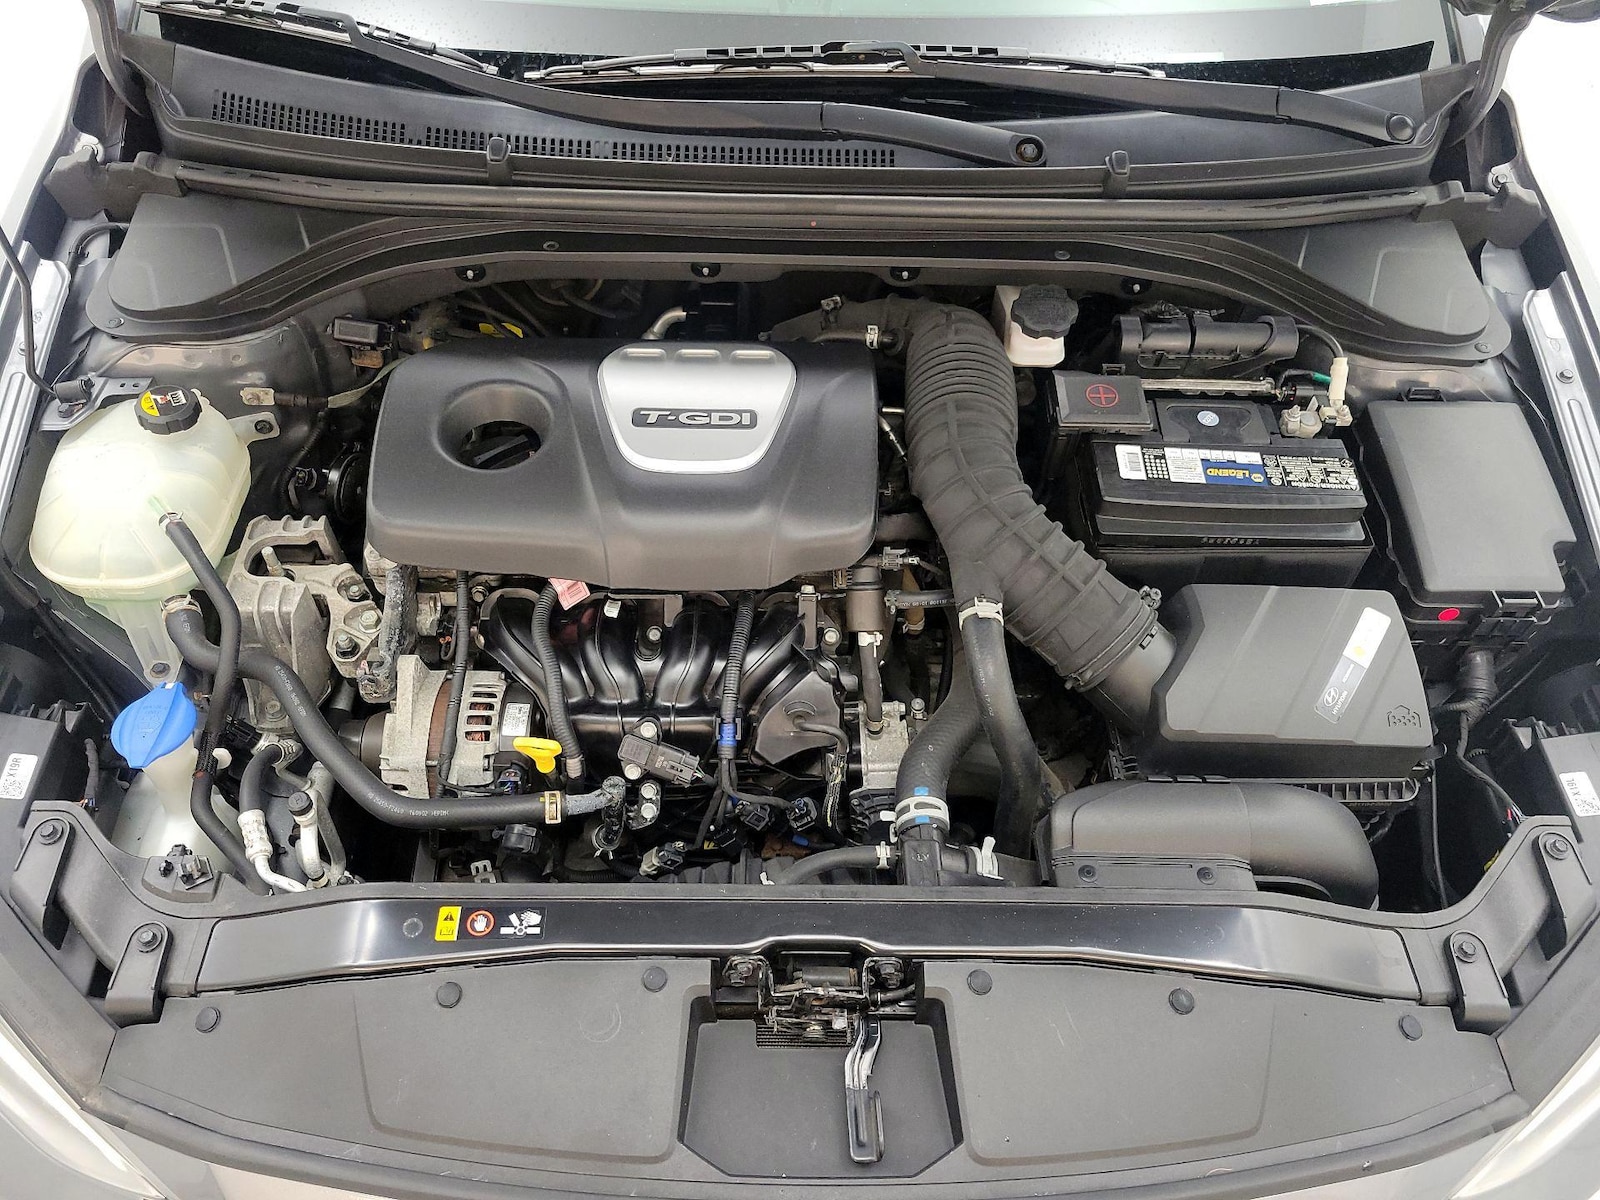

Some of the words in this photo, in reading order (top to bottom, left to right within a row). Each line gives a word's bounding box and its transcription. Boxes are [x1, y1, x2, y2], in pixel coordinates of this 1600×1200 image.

[640, 410, 751, 425] T-GDI
[1206, 467, 1250, 478] LEGEND
[1332, 690, 1348, 715] HYUNDAI
